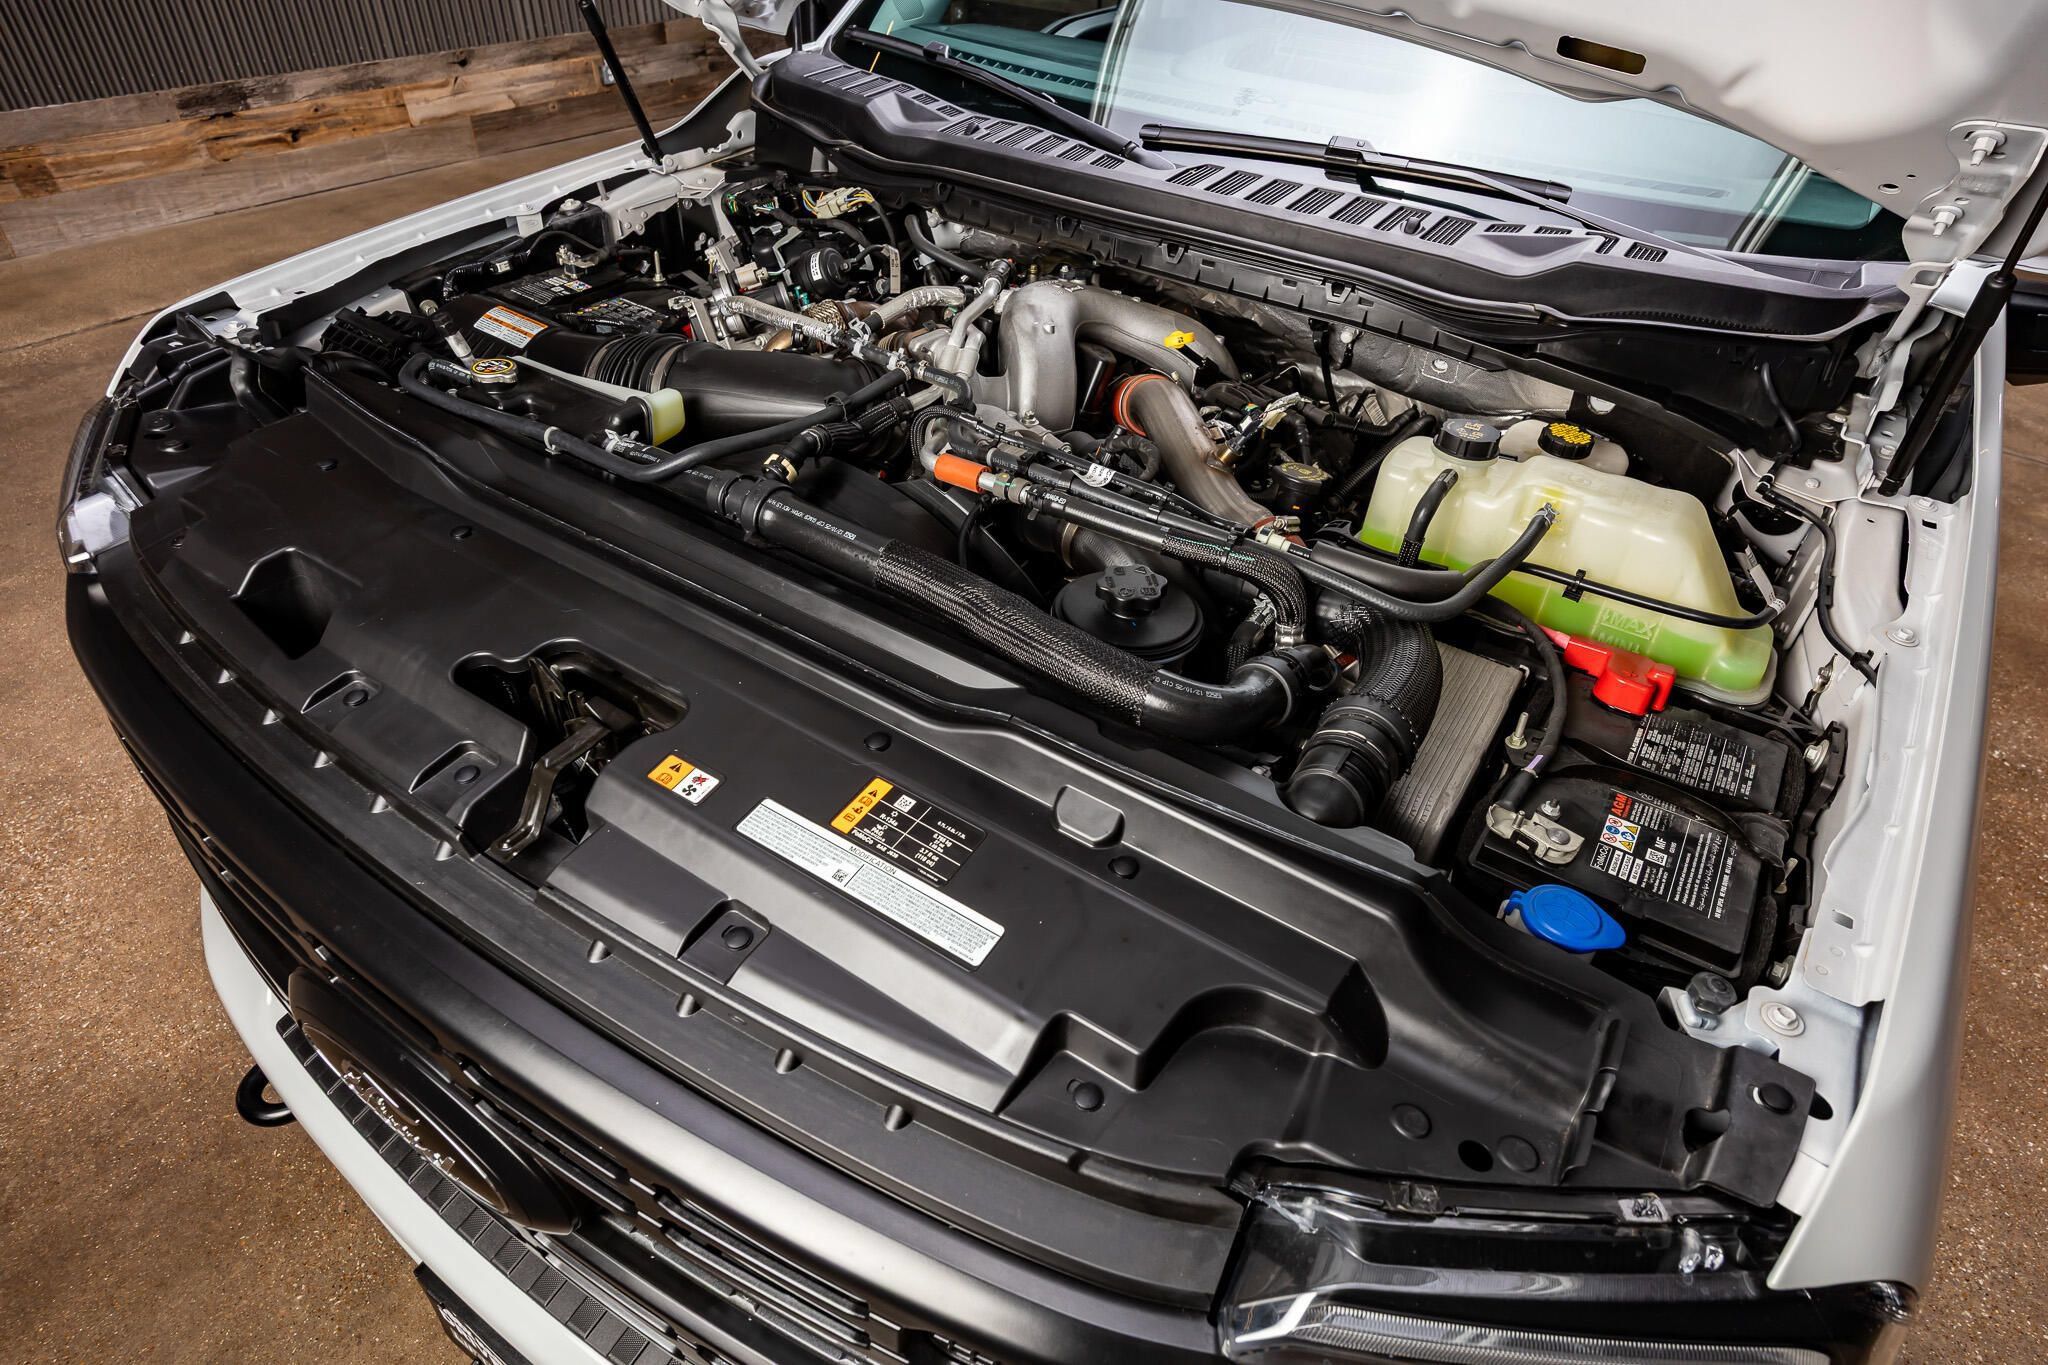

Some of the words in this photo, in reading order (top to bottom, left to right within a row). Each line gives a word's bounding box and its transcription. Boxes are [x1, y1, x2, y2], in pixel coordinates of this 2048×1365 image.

[1609, 611, 1657, 637] MAX
[1611, 793, 1627, 816] AGM
[872, 826, 884, 836] PAG
[879, 813, 899, 827] R-134a
[851, 829, 874, 844] FoMoCo
[875, 844, 887, 852] SAE
[1655, 837, 1666, 849] MF
[849, 846, 897, 875] MODIFICATION
[1594, 844, 1609, 868] FoMoCo
